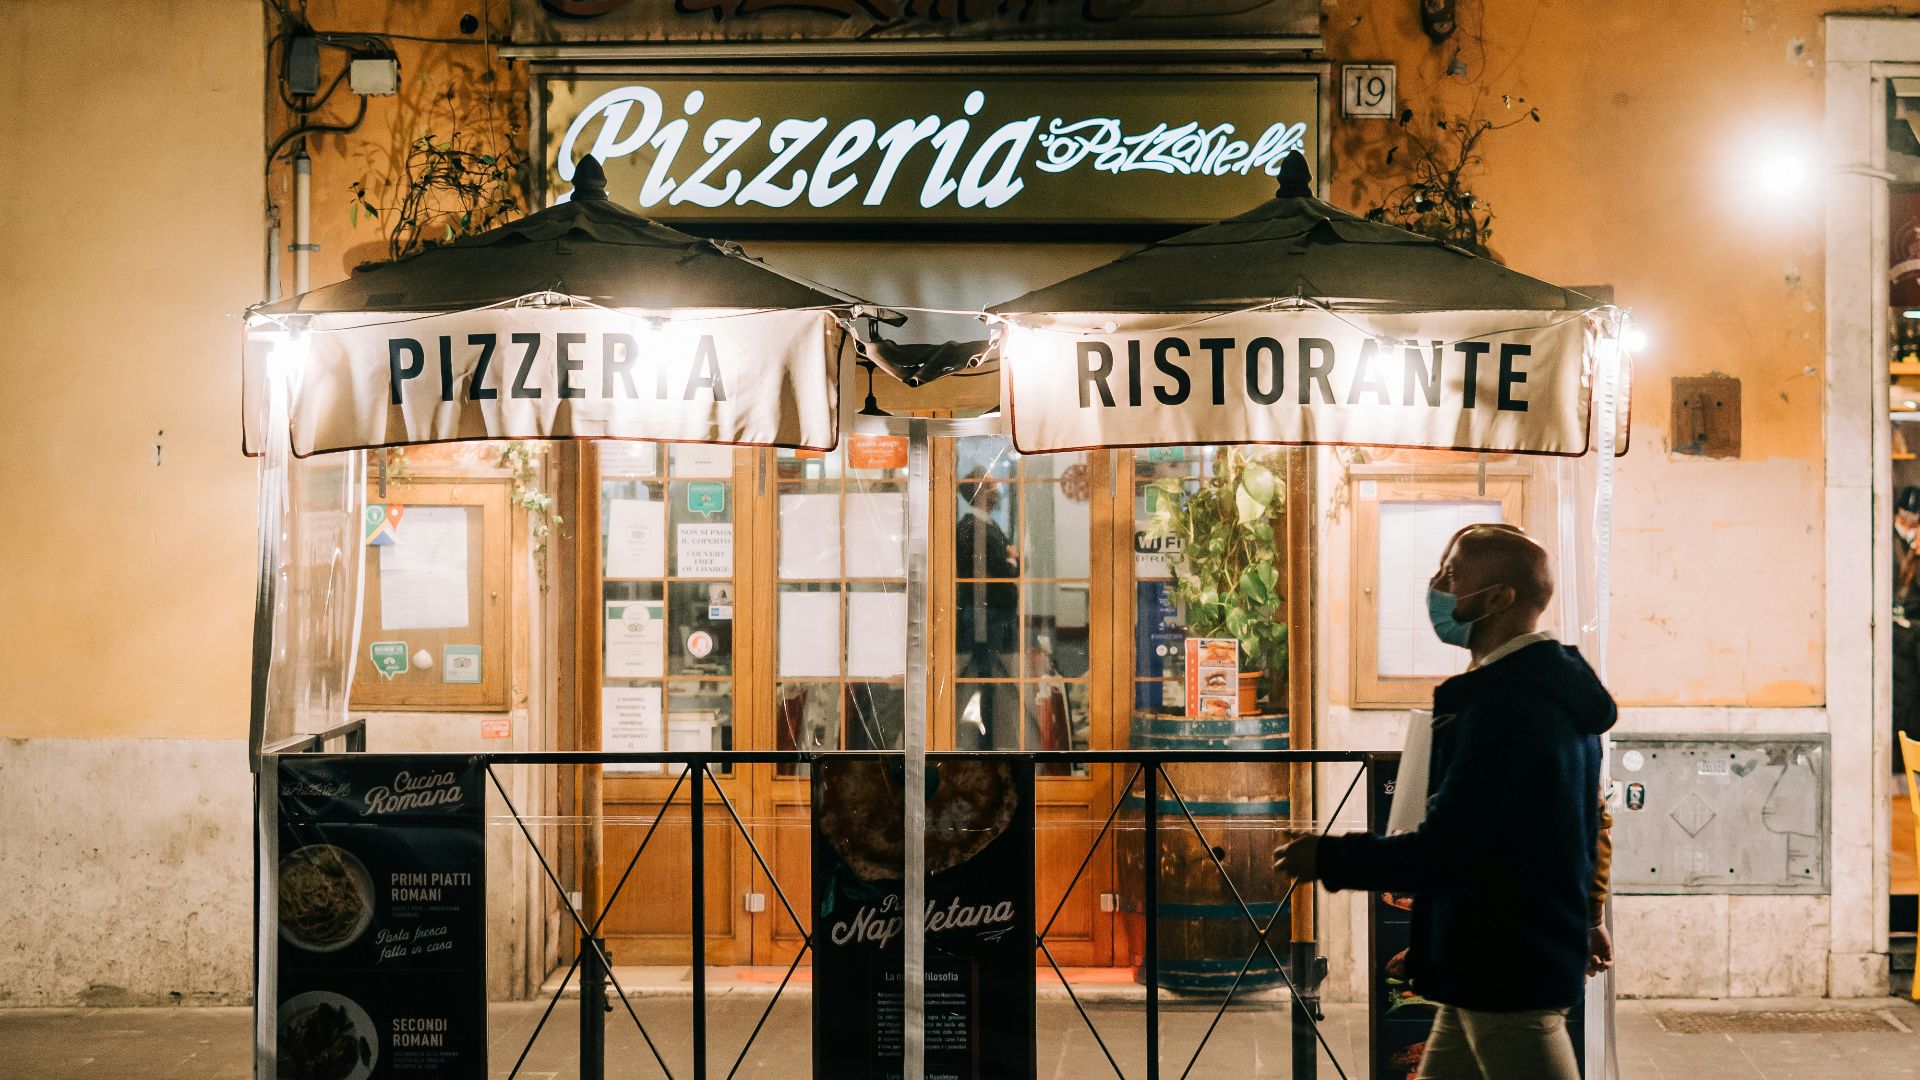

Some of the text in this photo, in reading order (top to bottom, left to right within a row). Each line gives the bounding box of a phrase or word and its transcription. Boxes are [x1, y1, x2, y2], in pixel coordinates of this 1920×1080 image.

[1355, 76, 1386, 107] 19
[556, 85, 1042, 209] Pizzeria
[387, 332, 727, 405] PIZZERIA
[1076, 336, 1530, 412] RISTORANTE
[394, 770, 458, 793] Cucina
[360, 784, 464, 817] Romana
[391, 872, 472, 887] PRIMI PIATTI
[391, 888, 442, 902] ROMANI
[831, 896, 1016, 949] Napletana
[376, 925, 448, 945] Pasta fresca
[377, 945, 407, 965] fatta
[427, 939, 453, 953] casa
[885, 970, 895, 982] La
[392, 1017, 448, 1032] SECONDI
[392, 1033, 443, 1048] ROMANI
